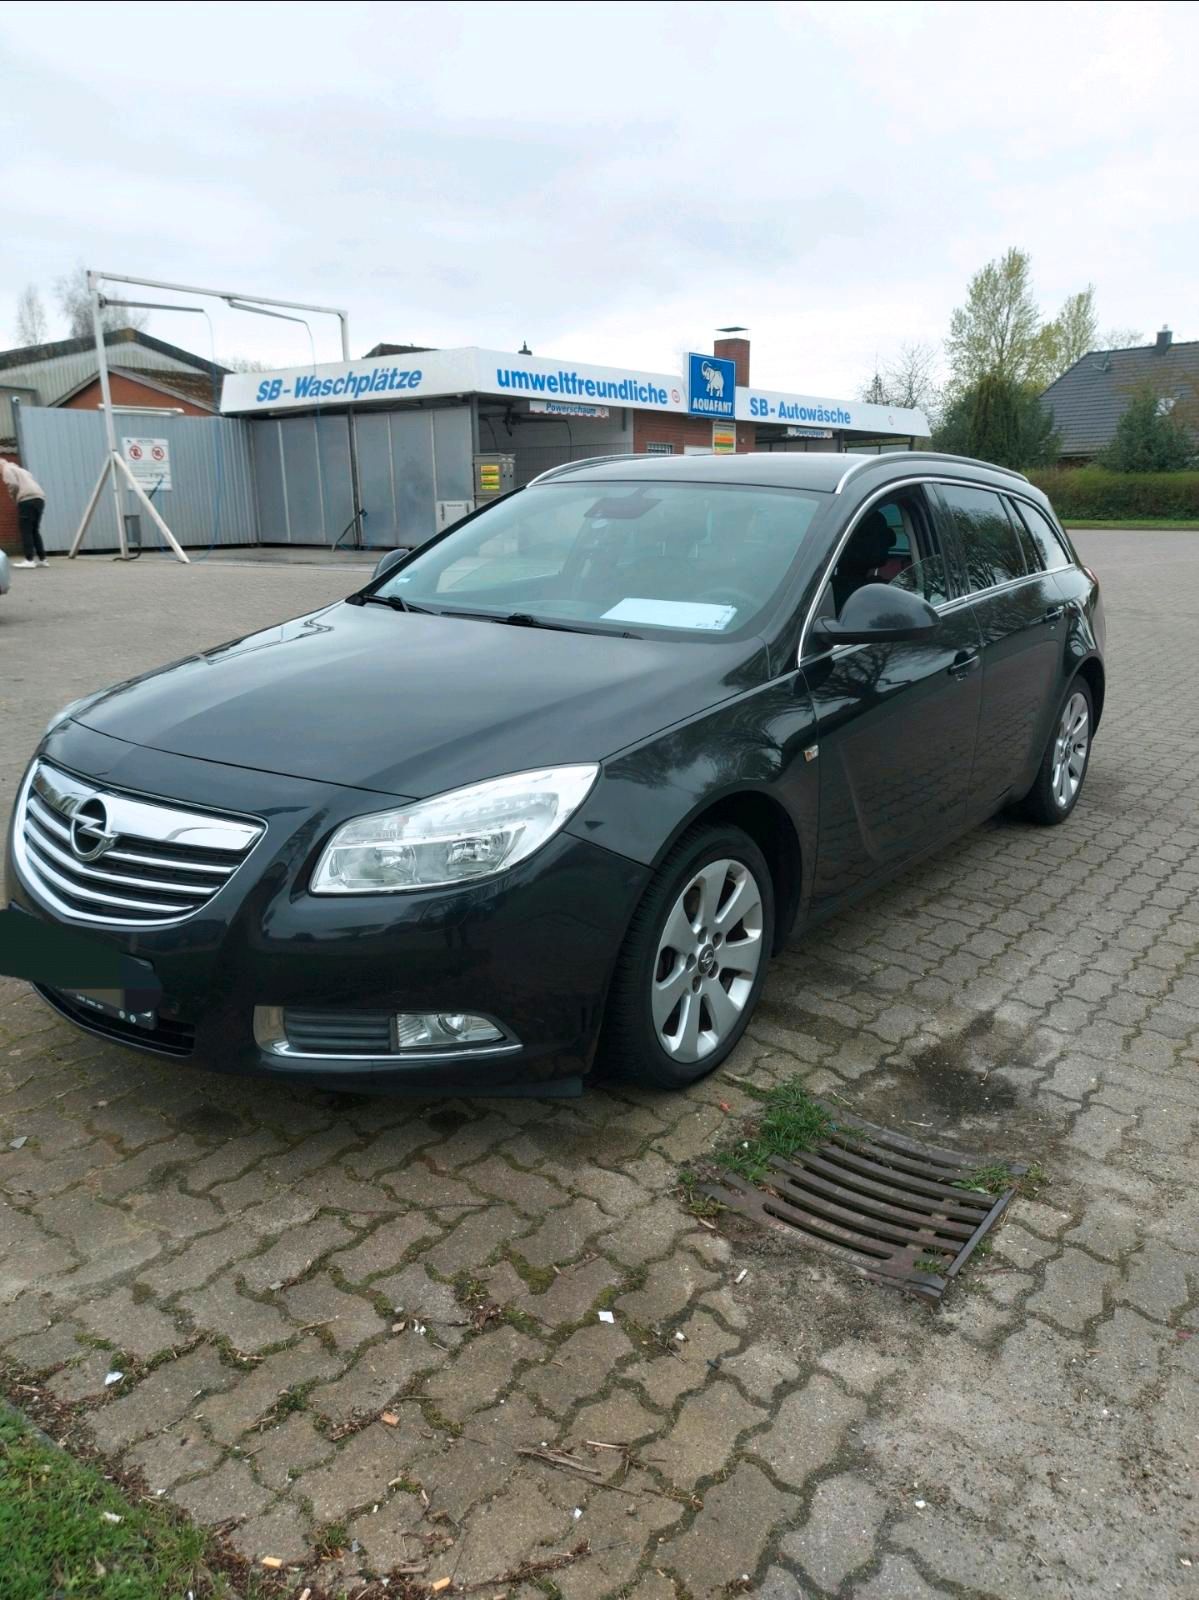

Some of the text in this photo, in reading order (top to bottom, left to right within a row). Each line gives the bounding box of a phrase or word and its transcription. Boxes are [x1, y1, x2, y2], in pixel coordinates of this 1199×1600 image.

[496, 369, 668, 404] umweltfreundliche
[546, 402, 596, 414] Powerschaum
[692, 398, 732, 414] AQUAFANT
